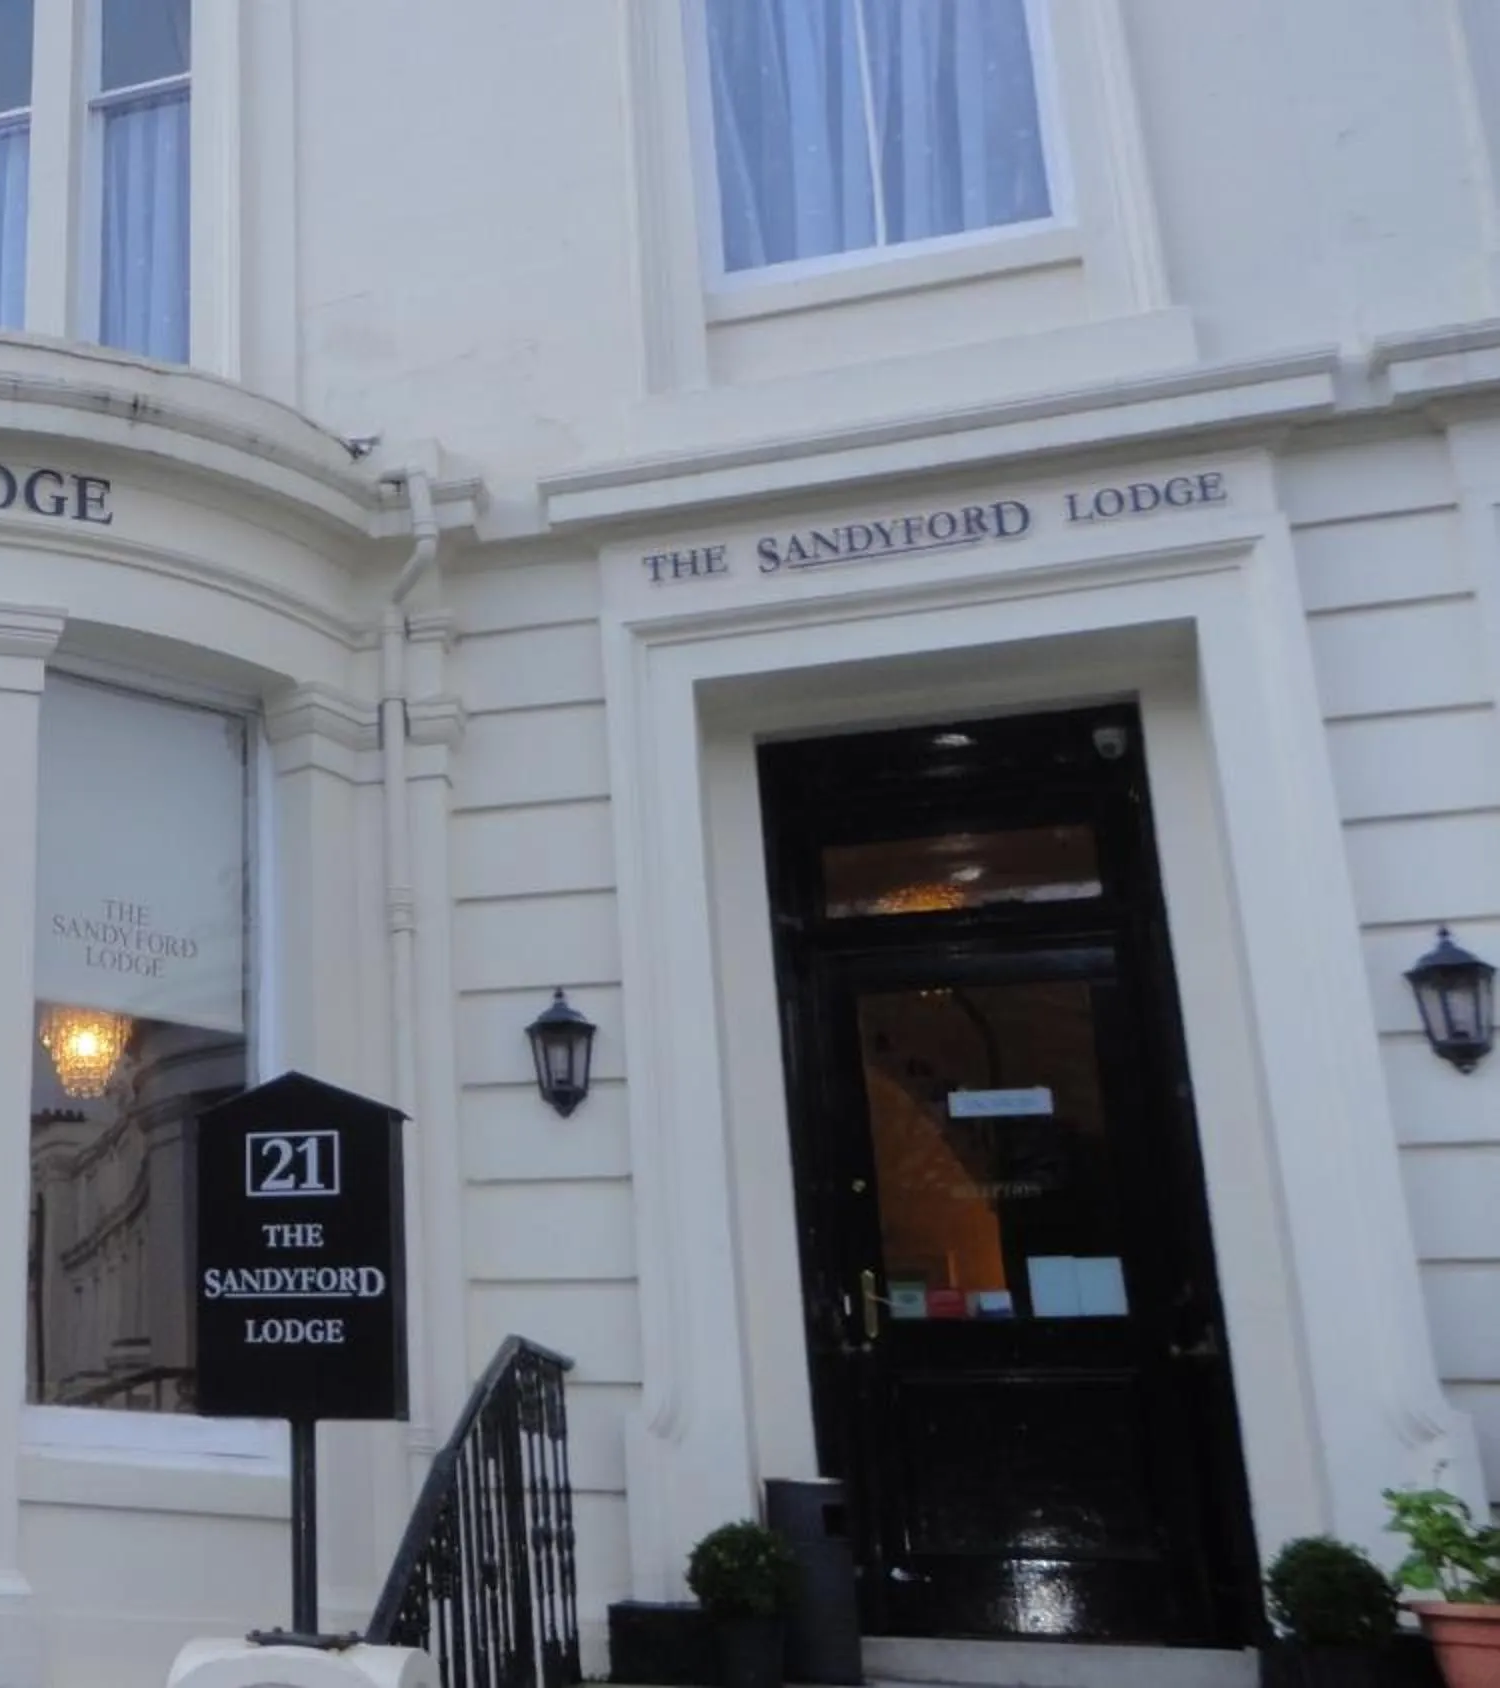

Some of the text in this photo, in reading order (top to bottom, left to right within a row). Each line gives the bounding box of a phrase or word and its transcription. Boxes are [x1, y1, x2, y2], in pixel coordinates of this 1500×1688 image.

[643, 471, 1228, 582] THE SANDYFORD LODGE
[102, 899, 150, 926] THE
[52, 914, 198, 959] SANDYFORD
[86, 946, 166, 978] LODGE
[260, 1137, 325, 1191] 21
[262, 1223, 324, 1248] THE
[204, 1266, 385, 1298] SANDYFORD
[244, 1319, 344, 1343] LODGE
